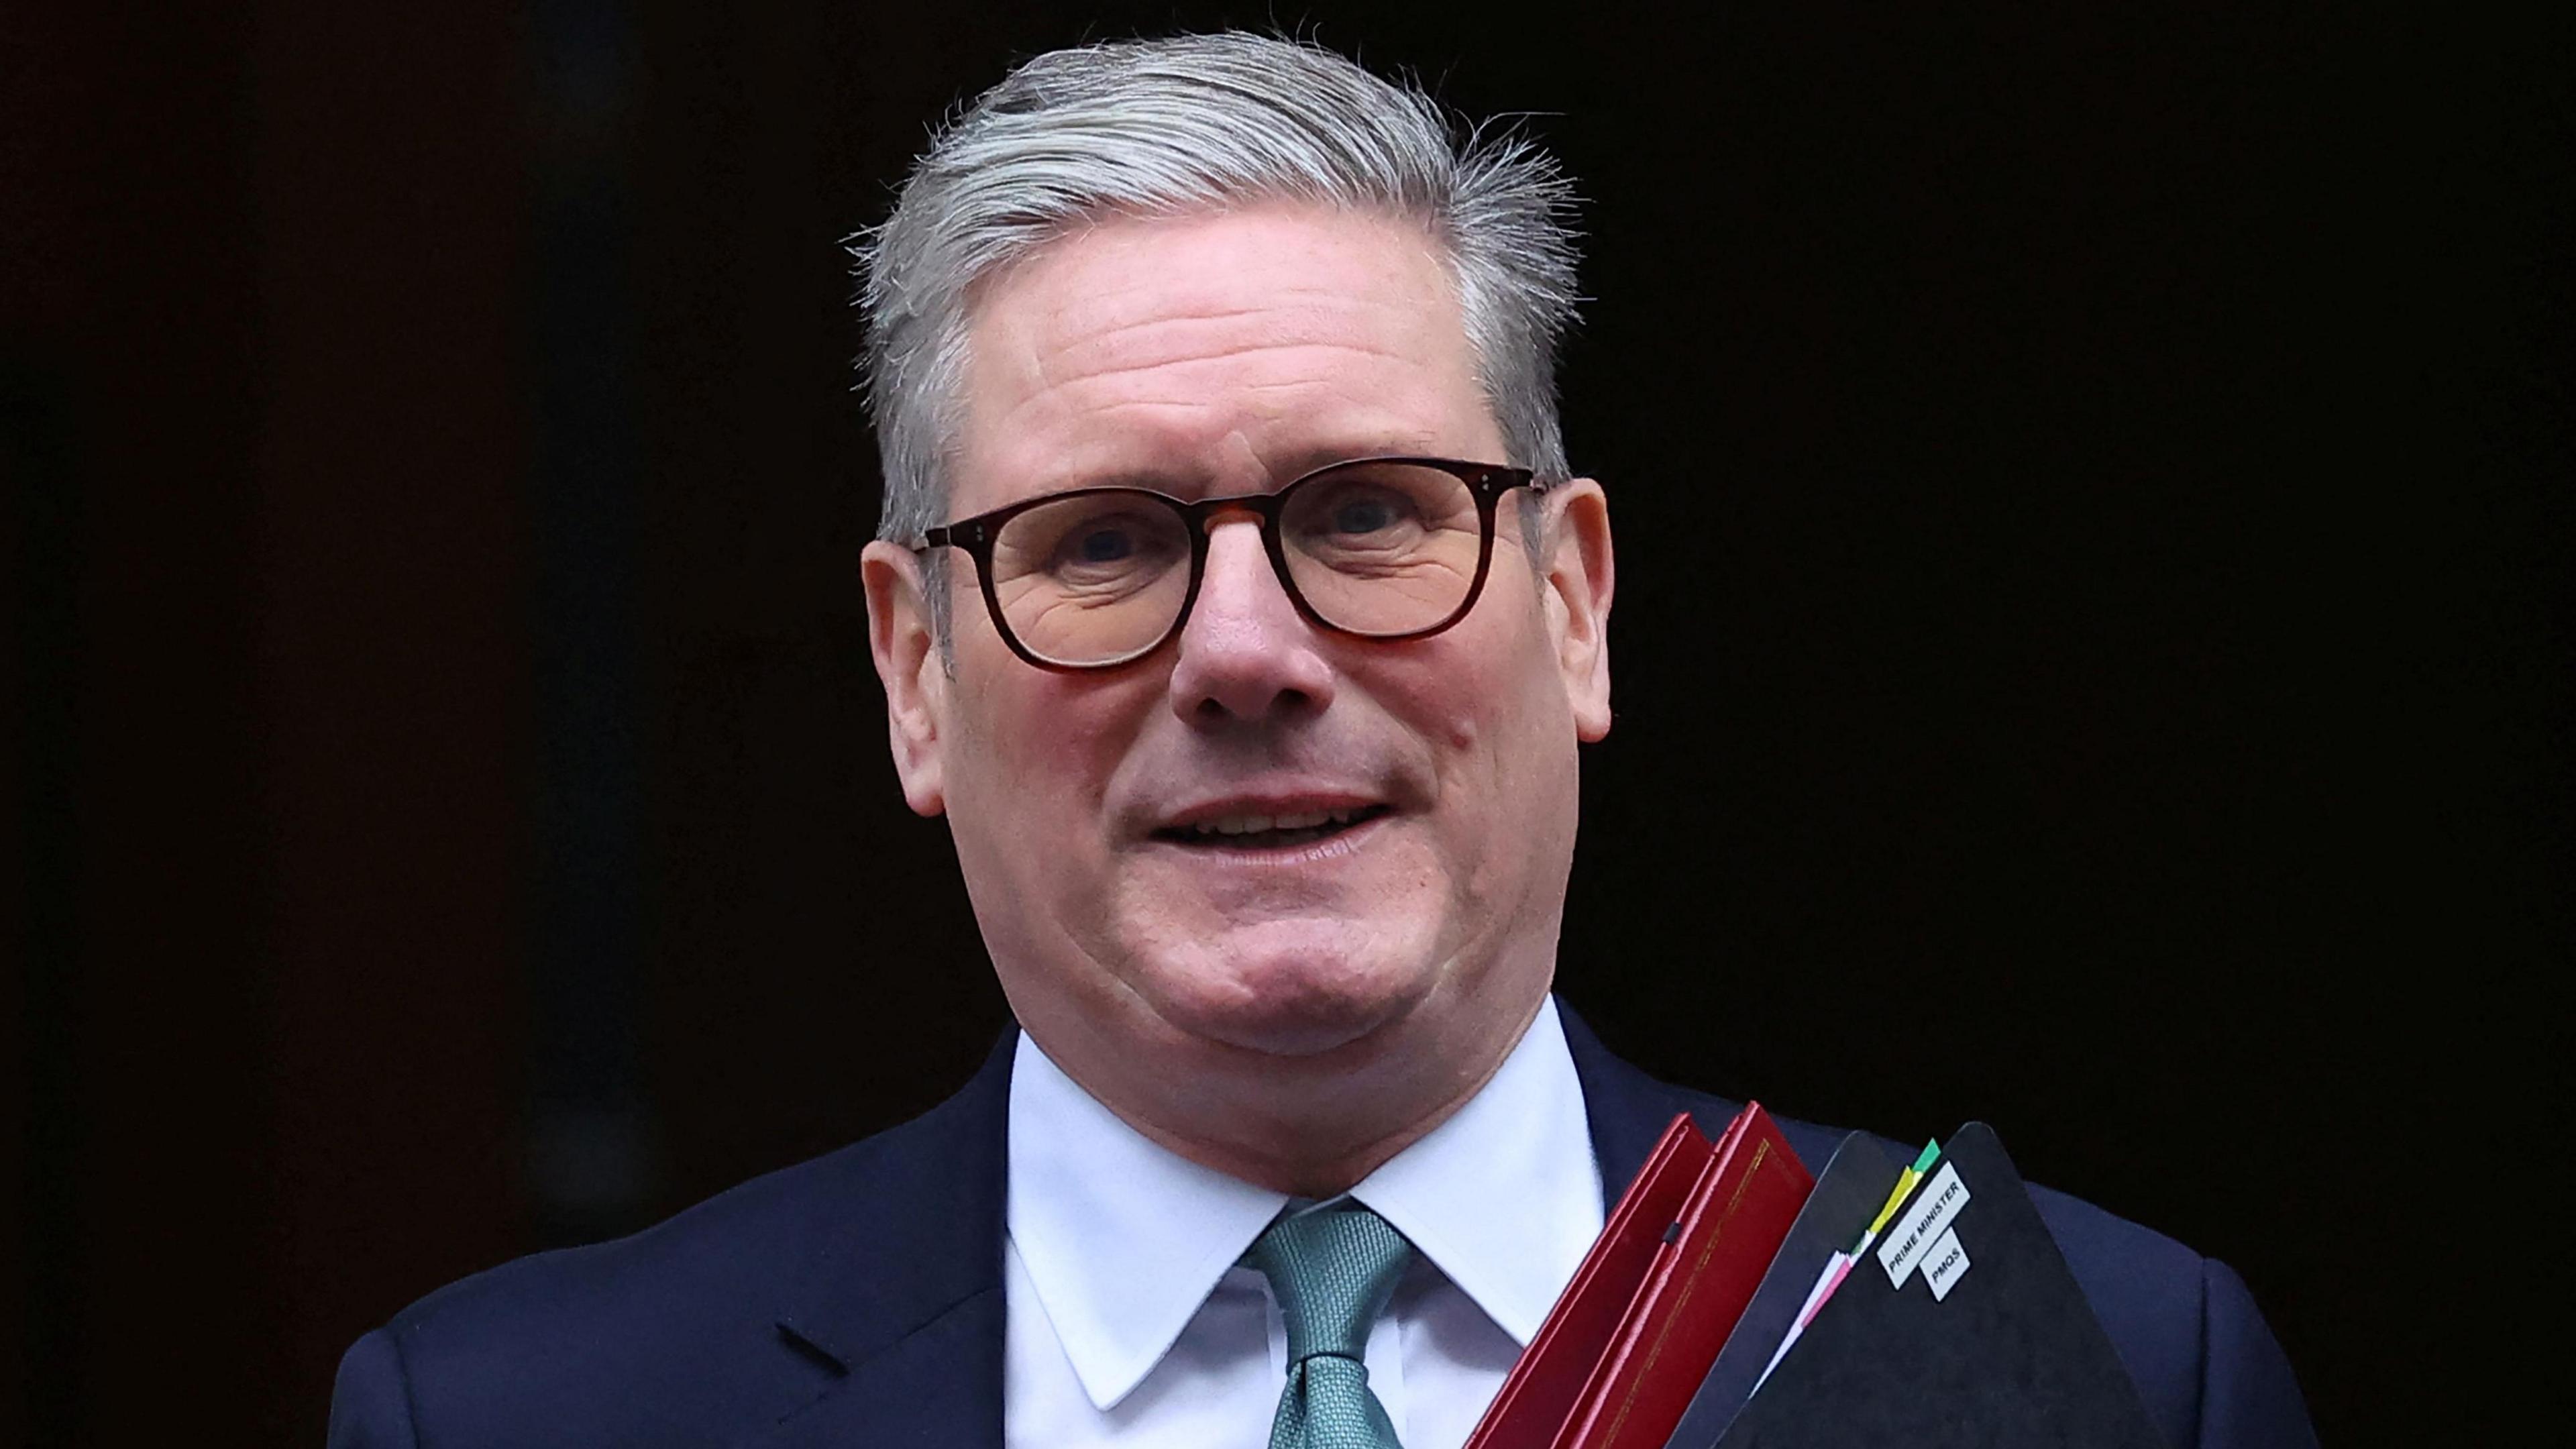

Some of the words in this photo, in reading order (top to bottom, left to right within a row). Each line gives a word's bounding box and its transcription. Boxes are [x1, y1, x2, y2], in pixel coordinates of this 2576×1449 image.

[1888, 1234, 1919, 1273] PRIME
[1917, 1181, 1960, 1237] MINISTER
[1931, 1247, 1961, 1283] PMQS
